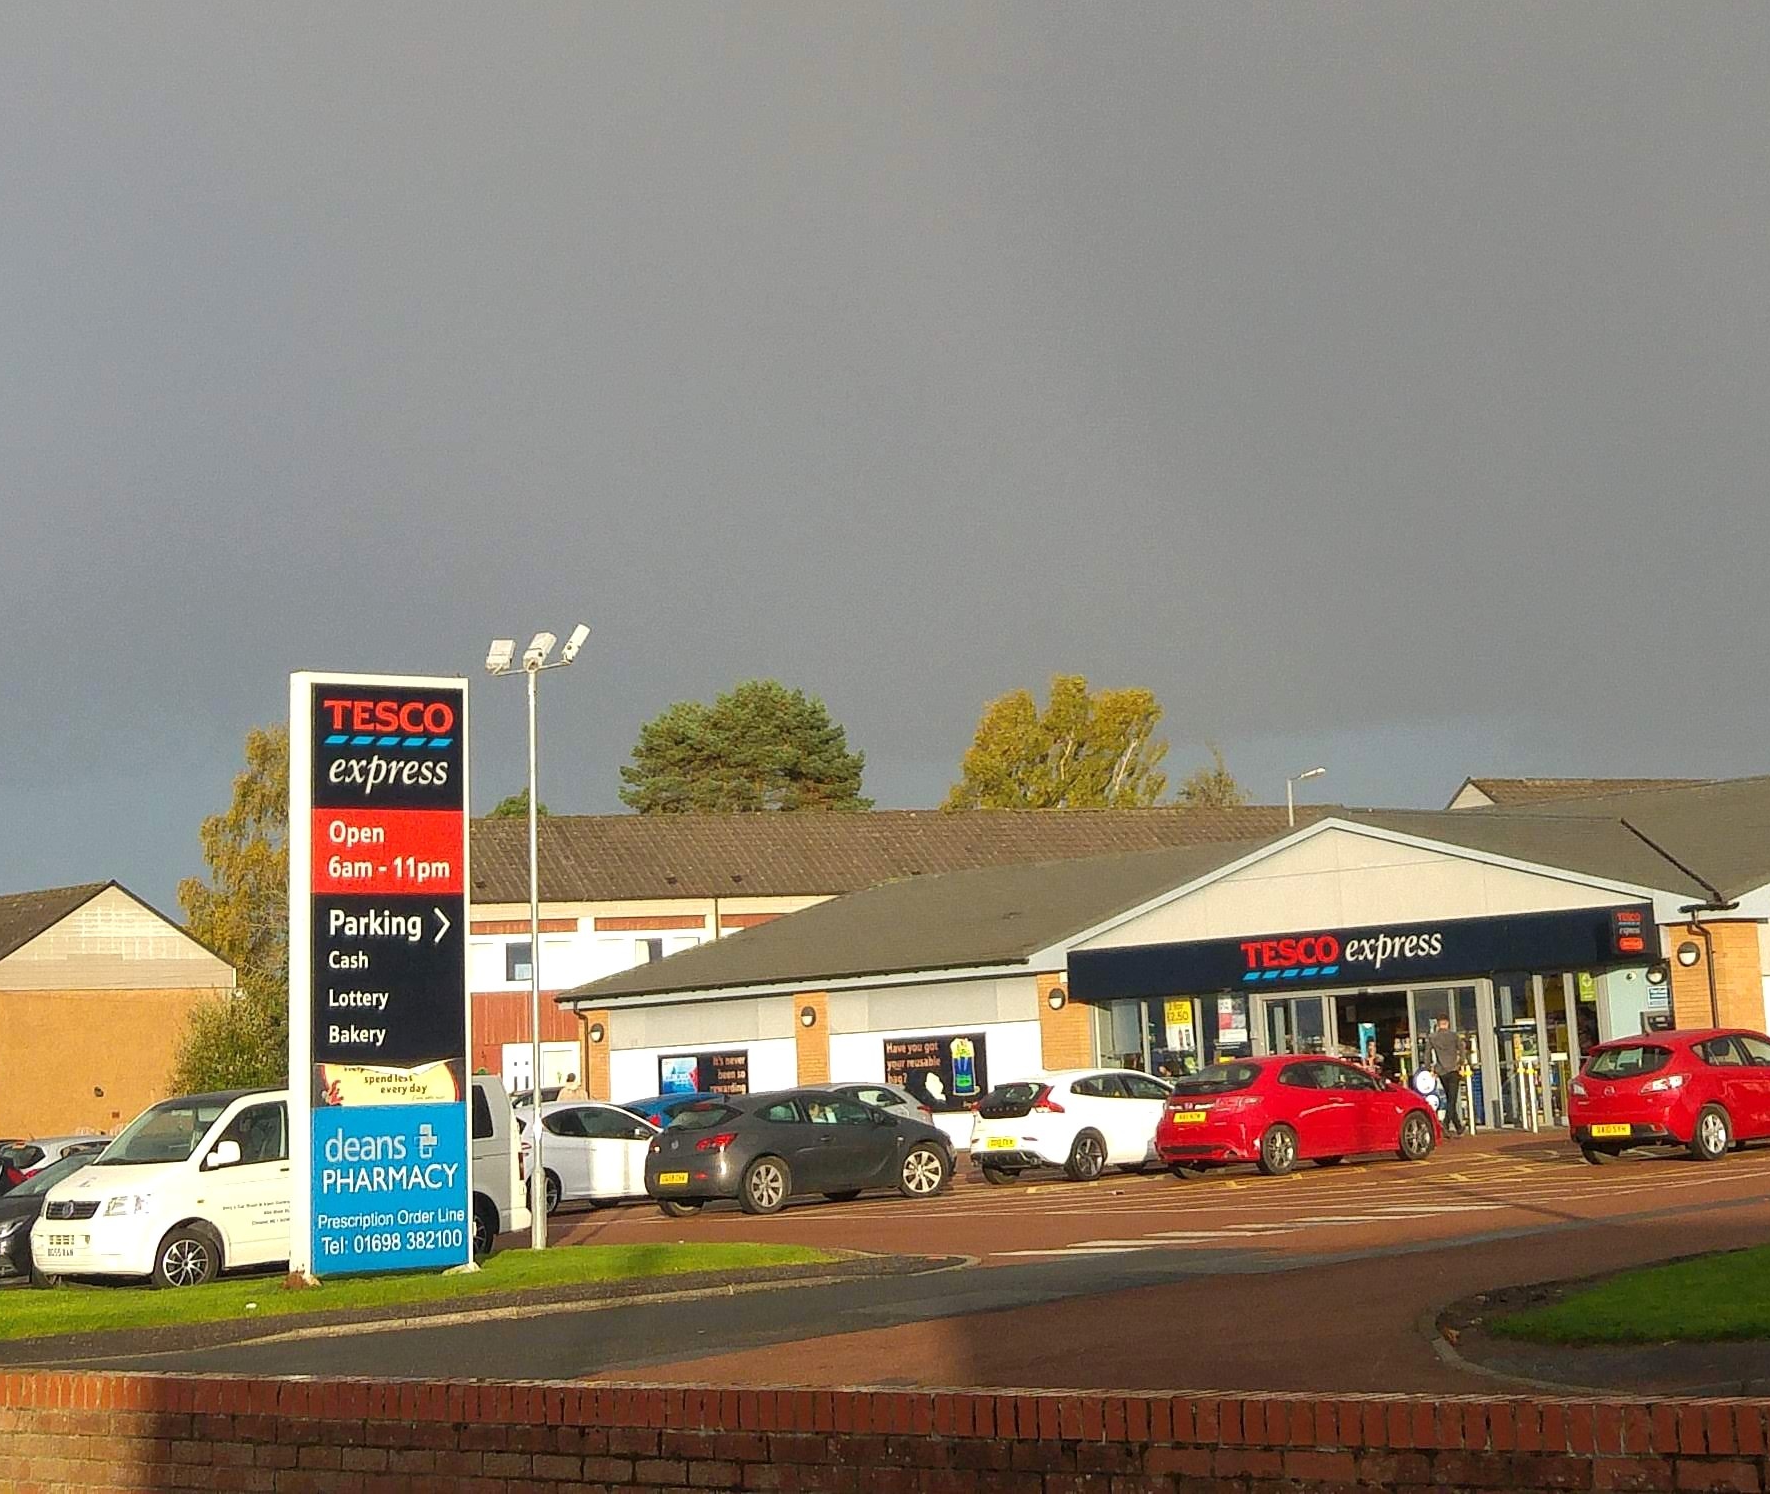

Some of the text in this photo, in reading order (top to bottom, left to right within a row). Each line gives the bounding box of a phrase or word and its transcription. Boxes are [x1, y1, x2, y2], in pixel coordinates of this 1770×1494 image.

[324, 700, 454, 733] TESCO
[329, 755, 449, 794] express
[329, 821, 385, 847] Open
[329, 856, 373, 879] 6am
[393, 857, 450, 883] 11pm
[329, 909, 422, 942] Parking
[329, 951, 369, 970] Cash
[1240, 932, 1442, 969] TESCO express
[329, 989, 389, 1010] Lottery
[329, 1025, 386, 1046] Bakery
[886, 1042, 939, 1054] Have you got
[887, 1056, 941, 1071] your reusable
[364, 1074, 393, 1086] spend
[380, 1084, 427, 1095] every day
[325, 1128, 406, 1163] deans
[323, 1163, 458, 1194] PHARMACY
[318, 1207, 465, 1230] Prescription Order Line
[322, 1229, 462, 1255] Tel: 01698 382100
